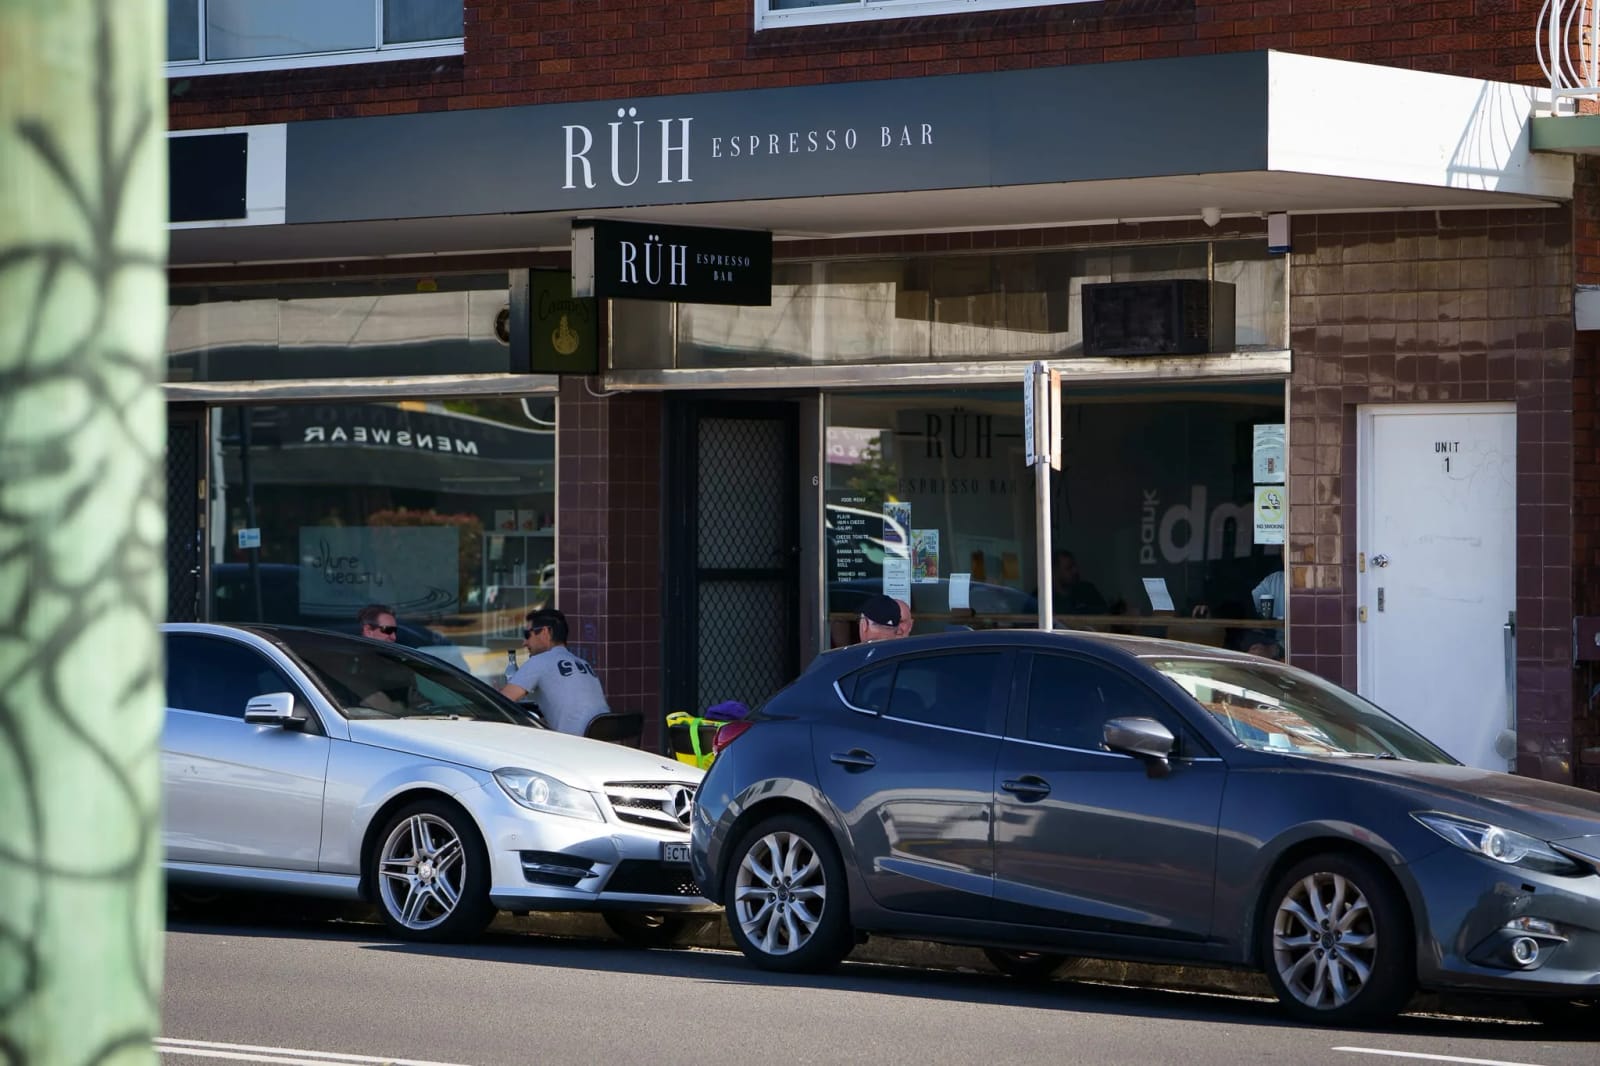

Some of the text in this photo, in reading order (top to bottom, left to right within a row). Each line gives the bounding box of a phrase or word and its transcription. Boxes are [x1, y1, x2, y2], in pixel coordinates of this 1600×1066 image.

[561, 107, 934, 189] RÜH ESPRESSO BAR
[620, 234, 751, 286] RÜH ESPRESSO
[713, 270, 734, 282] BAR
[925, 406, 993, 459] RÜH
[1435, 442, 1460, 453] UNIT
[1445, 457, 1450, 472] 1
[812, 475, 819, 487] 6
